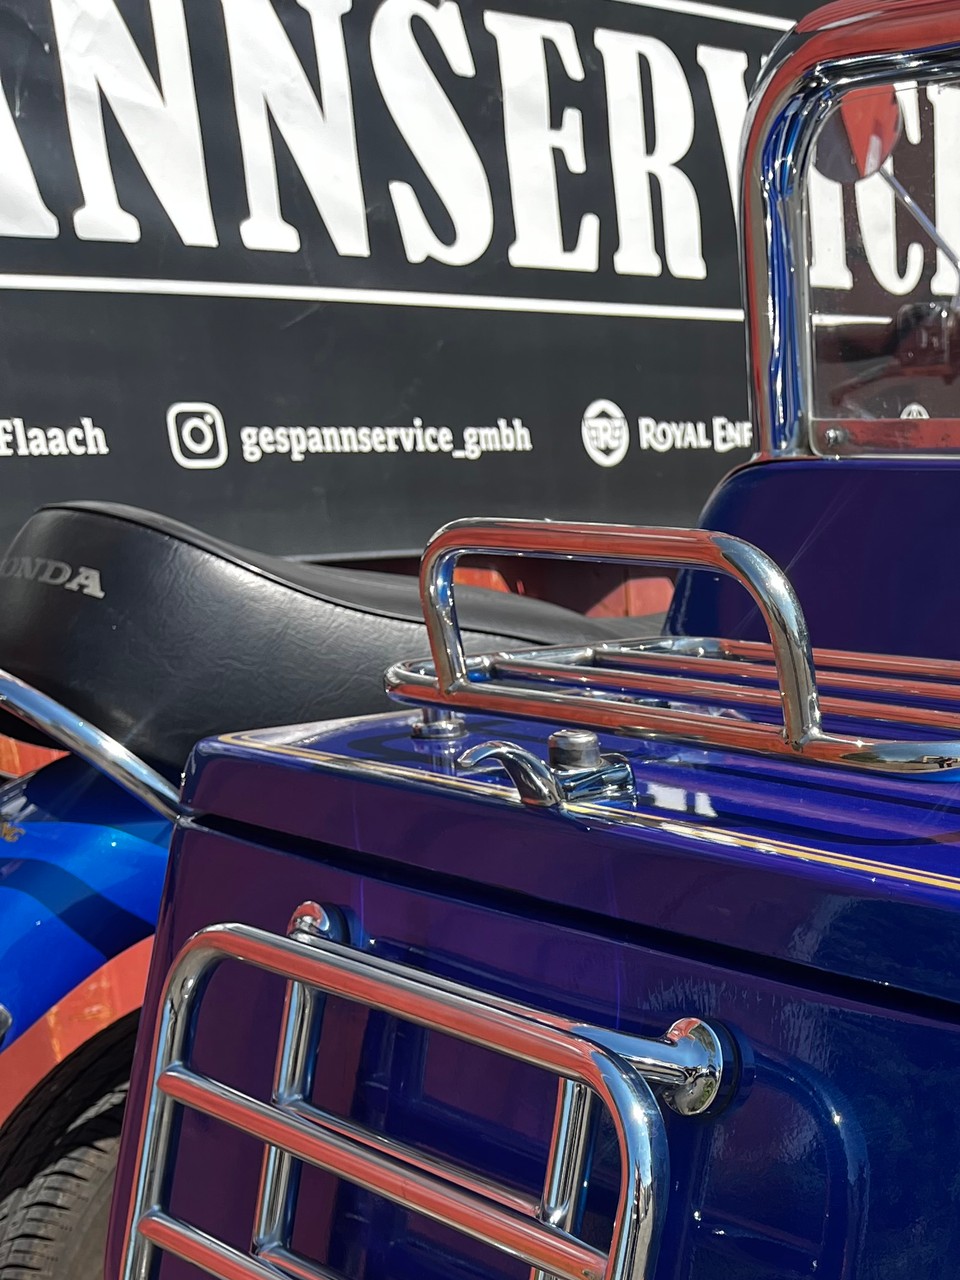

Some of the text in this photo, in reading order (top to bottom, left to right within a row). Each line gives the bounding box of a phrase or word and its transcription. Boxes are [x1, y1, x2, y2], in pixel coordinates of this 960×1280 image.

[0, 416, 109, 456] Flaach
[239, 416, 533, 462] gespannservice_gmbh
[638, 416, 711, 452] ROYAL
